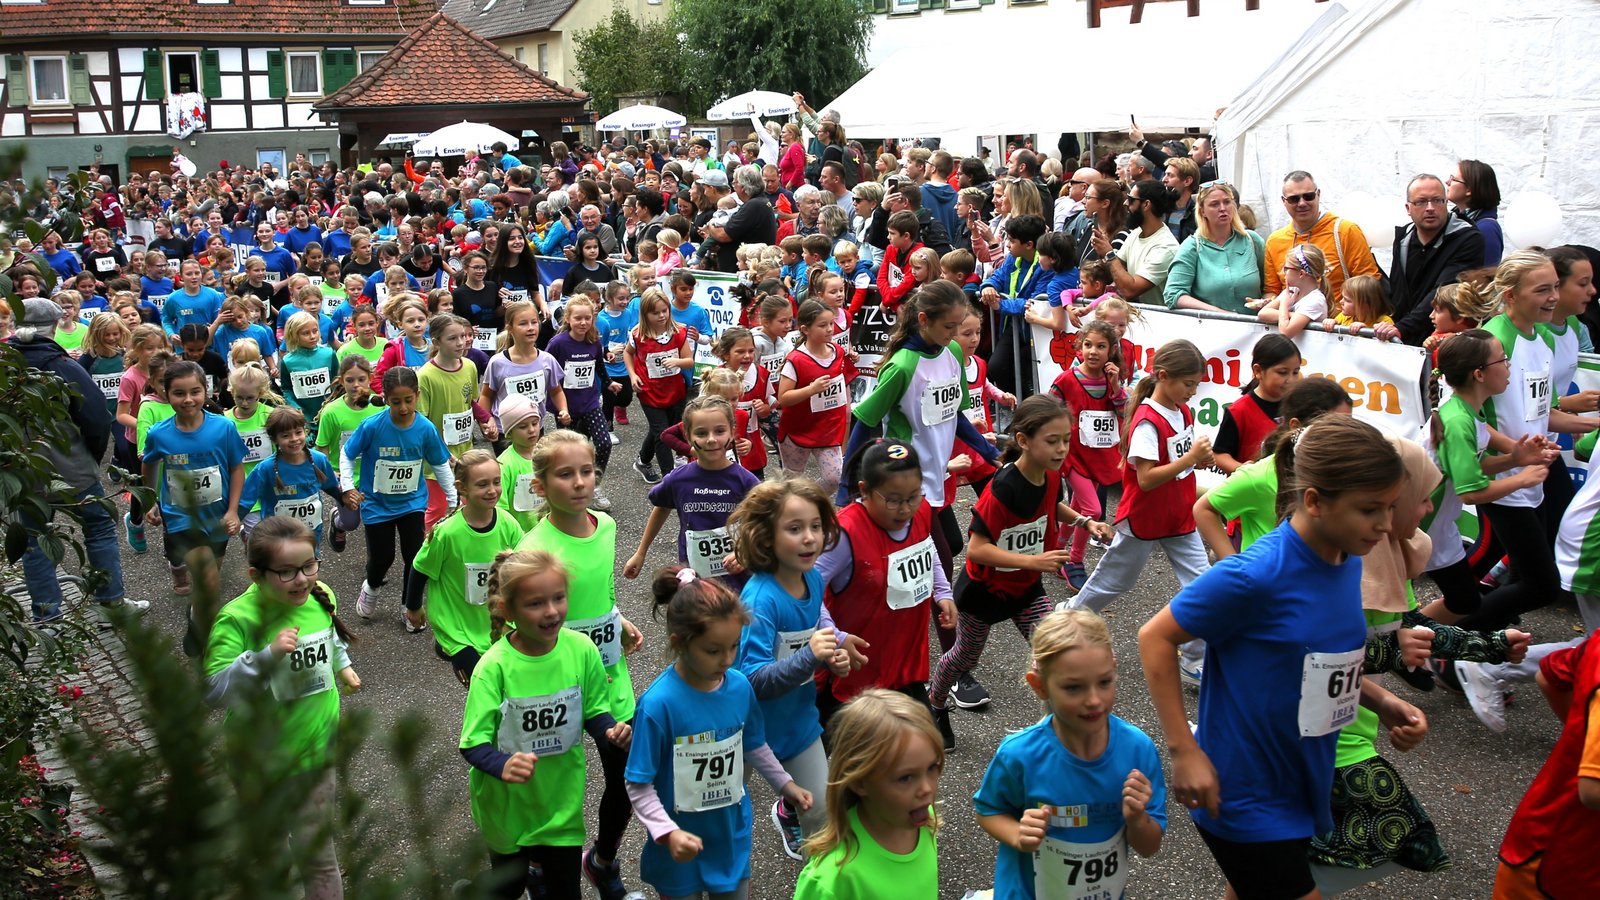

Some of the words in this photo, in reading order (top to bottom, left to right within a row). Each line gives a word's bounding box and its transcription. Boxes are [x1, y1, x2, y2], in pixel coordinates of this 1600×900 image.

[732, 110, 756, 118] Ensing
[767, 106, 791, 115] Ensinger
[631, 122, 657, 130] Ensinger
[389, 134, 409, 142] Ensinger
[443, 147, 467, 155] Ensing
[893, 270, 905, 282] 96
[420, 279, 434, 287] 670
[477, 332, 492, 341] 657
[574, 366, 593, 378] 927
[97, 377, 121, 389] 1069
[298, 373, 326, 387] 1066
[516, 378, 539, 394] 691
[932, 384, 960, 405] 1096
[455, 416, 472, 431] 689
[1093, 418, 1115, 432] 959
[242, 436, 262, 448] 46
[388, 467, 413, 480] 708
[693, 487, 731, 496] Roßwager
[288, 503, 316, 518] 709
[698, 536, 735, 558] 935
[896, 551, 932, 585] 1010
[580, 623, 614, 647] 68
[290, 643, 328, 673] 864
[521, 703, 568, 733] 862
[531, 736, 562, 750] IBEK
[685, 751, 709, 759] Ensinger
[692, 750, 736, 783] 797
[706, 781, 727, 789] Selina
[701, 786, 732, 801] IBEK
[1055, 848, 1084, 860] Ensinger
[1063, 850, 1119, 887] 798
[1086, 884, 1102, 892] Lea
